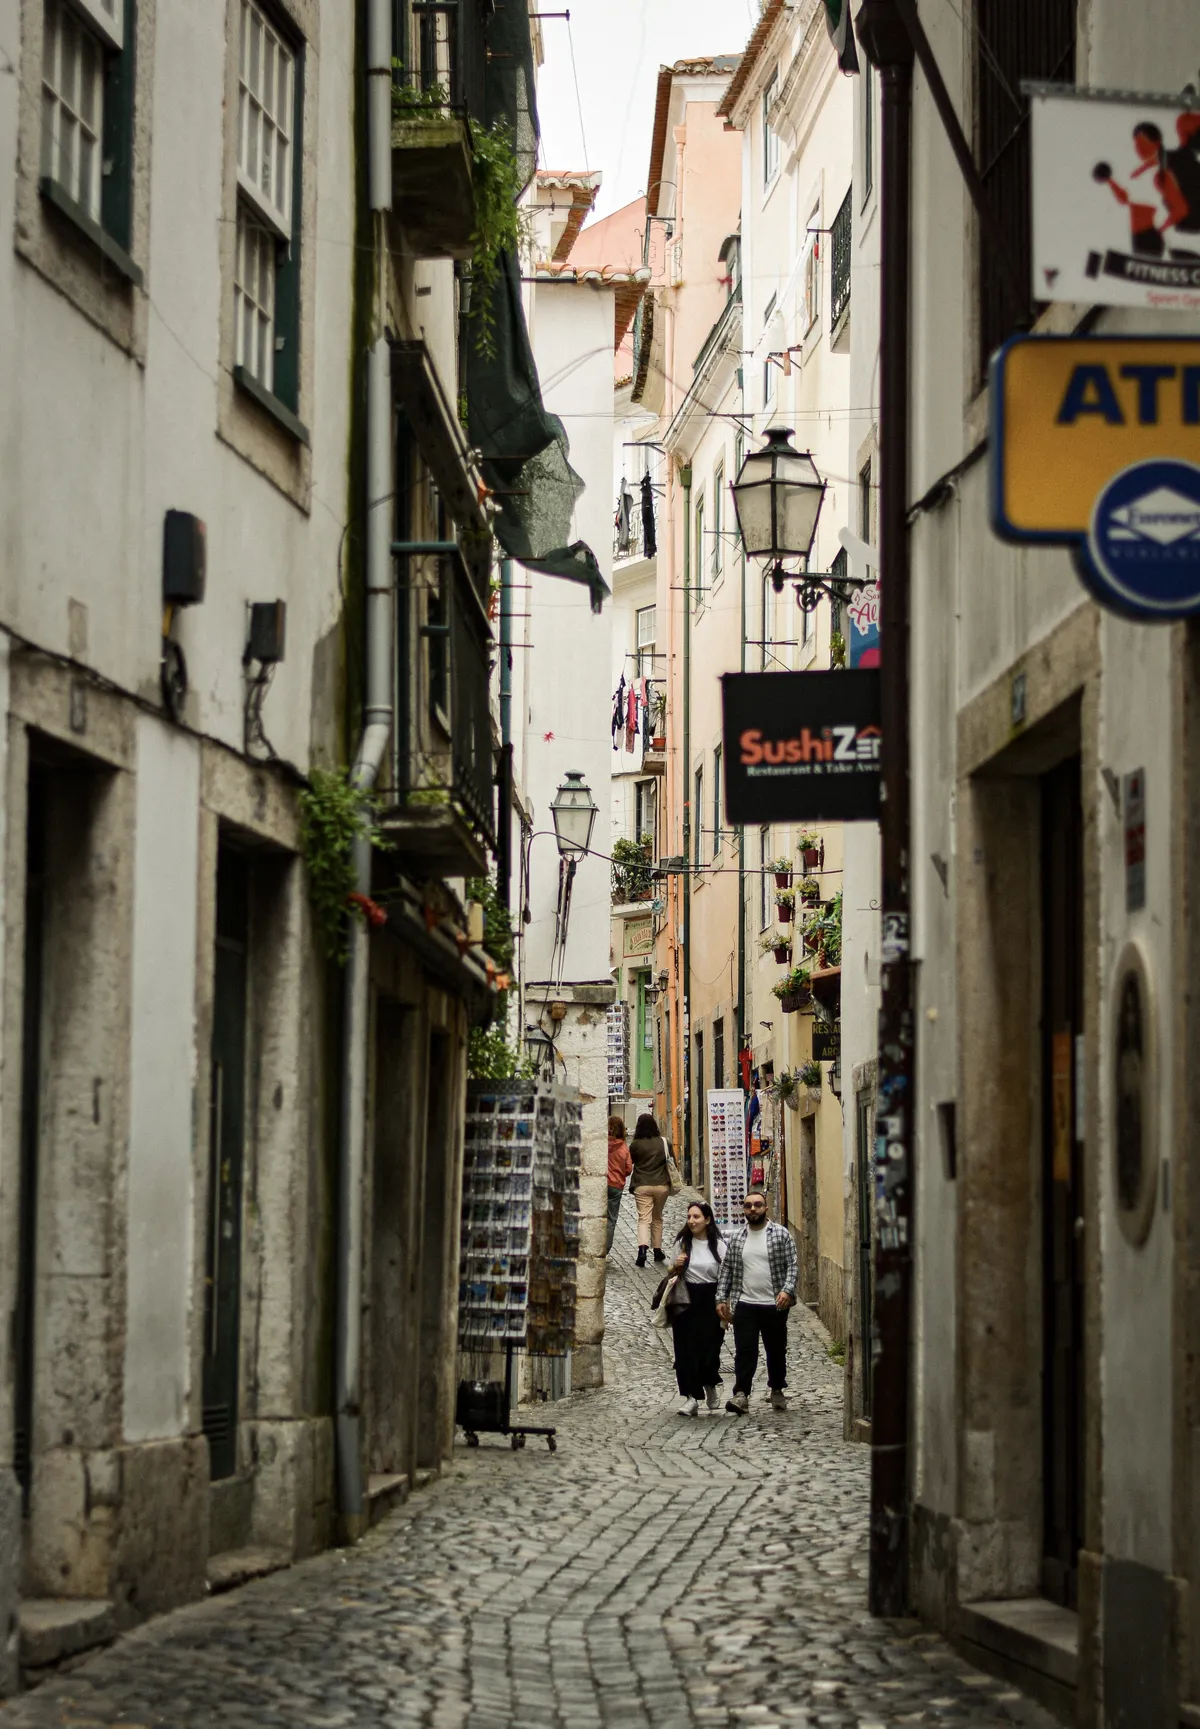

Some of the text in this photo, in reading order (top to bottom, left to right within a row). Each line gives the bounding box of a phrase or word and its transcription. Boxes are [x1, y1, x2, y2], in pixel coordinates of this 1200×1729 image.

[1125, 259, 1188, 283] FITNESS
[747, 764, 811, 777] Restaurant
[813, 763, 823, 774] &
[825, 762, 853, 774] Take
